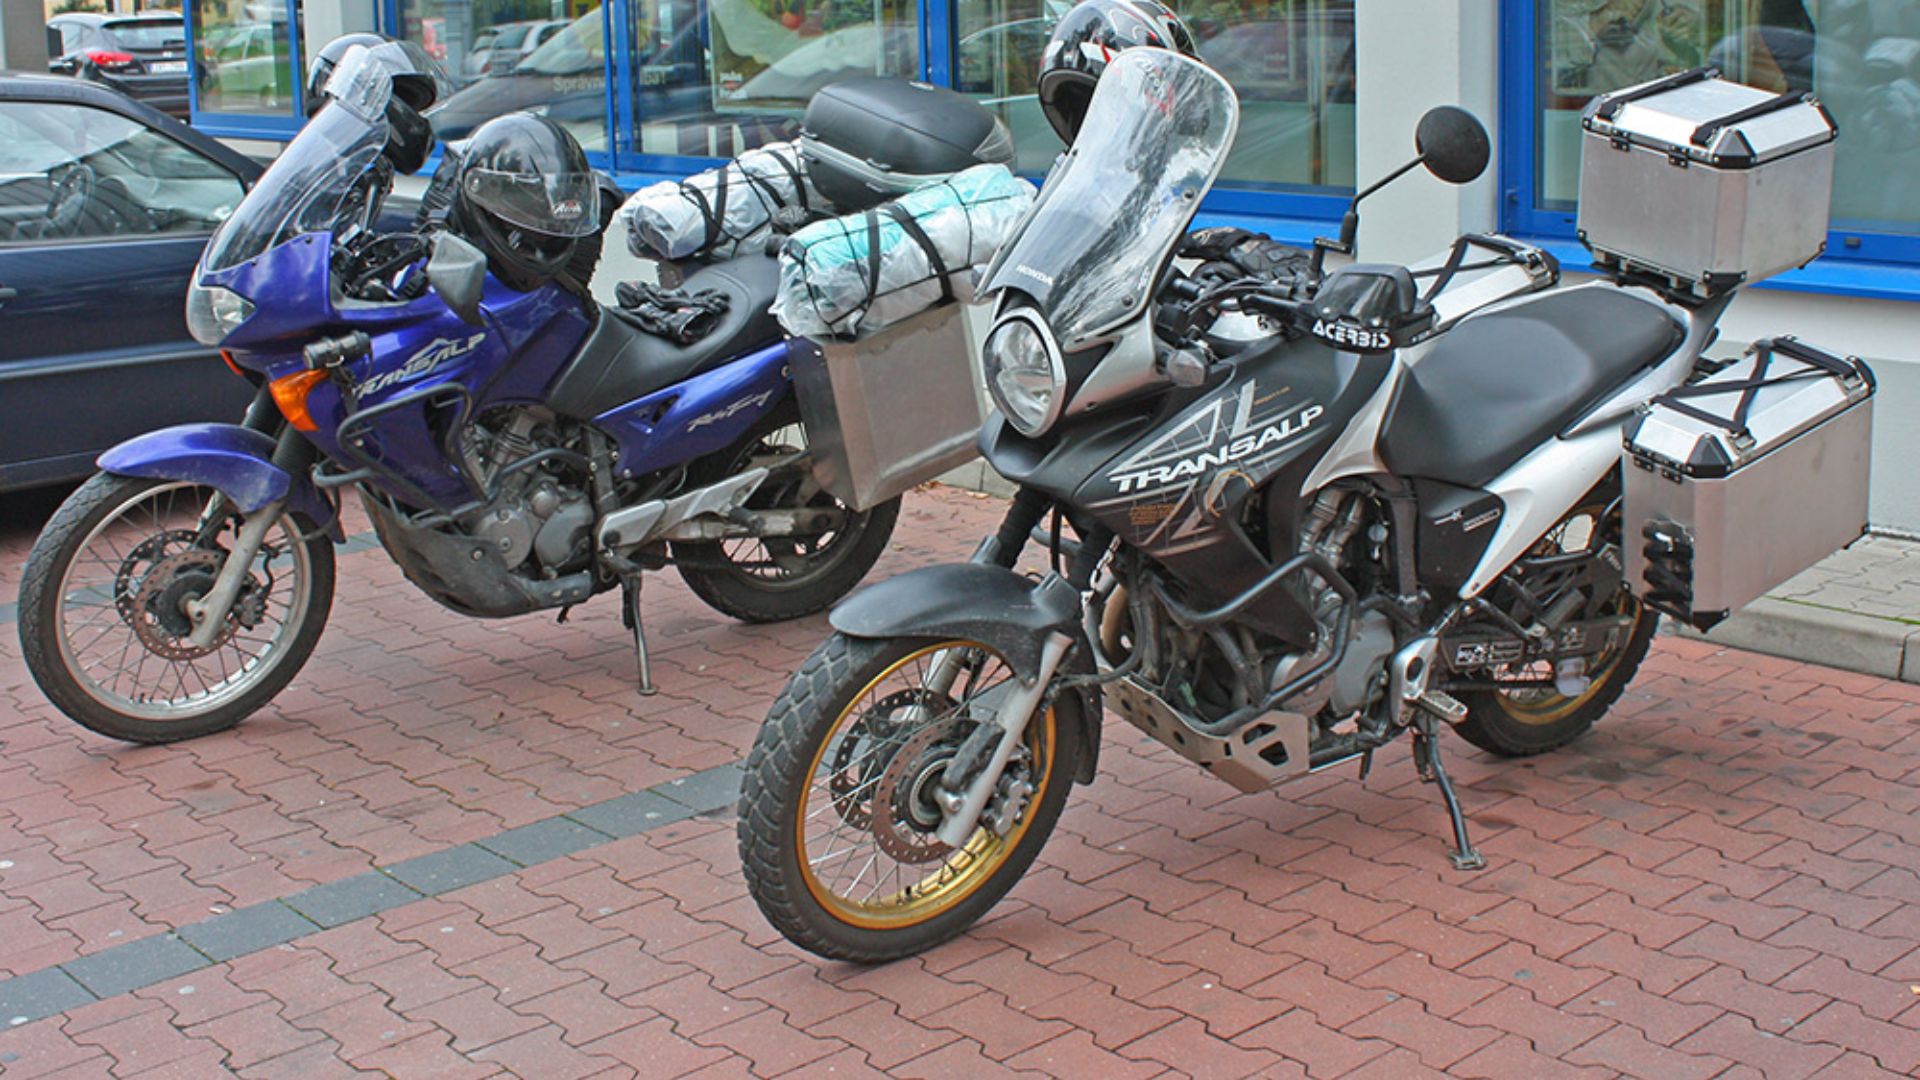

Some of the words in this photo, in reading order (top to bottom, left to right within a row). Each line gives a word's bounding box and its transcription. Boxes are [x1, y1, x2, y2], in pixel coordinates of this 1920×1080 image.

[553, 75, 606, 95] Správn
[1016, 265, 1054, 286] HONDA
[1312, 319, 1391, 348] ACERBIS
[1110, 404, 1324, 493] TRANSALP
